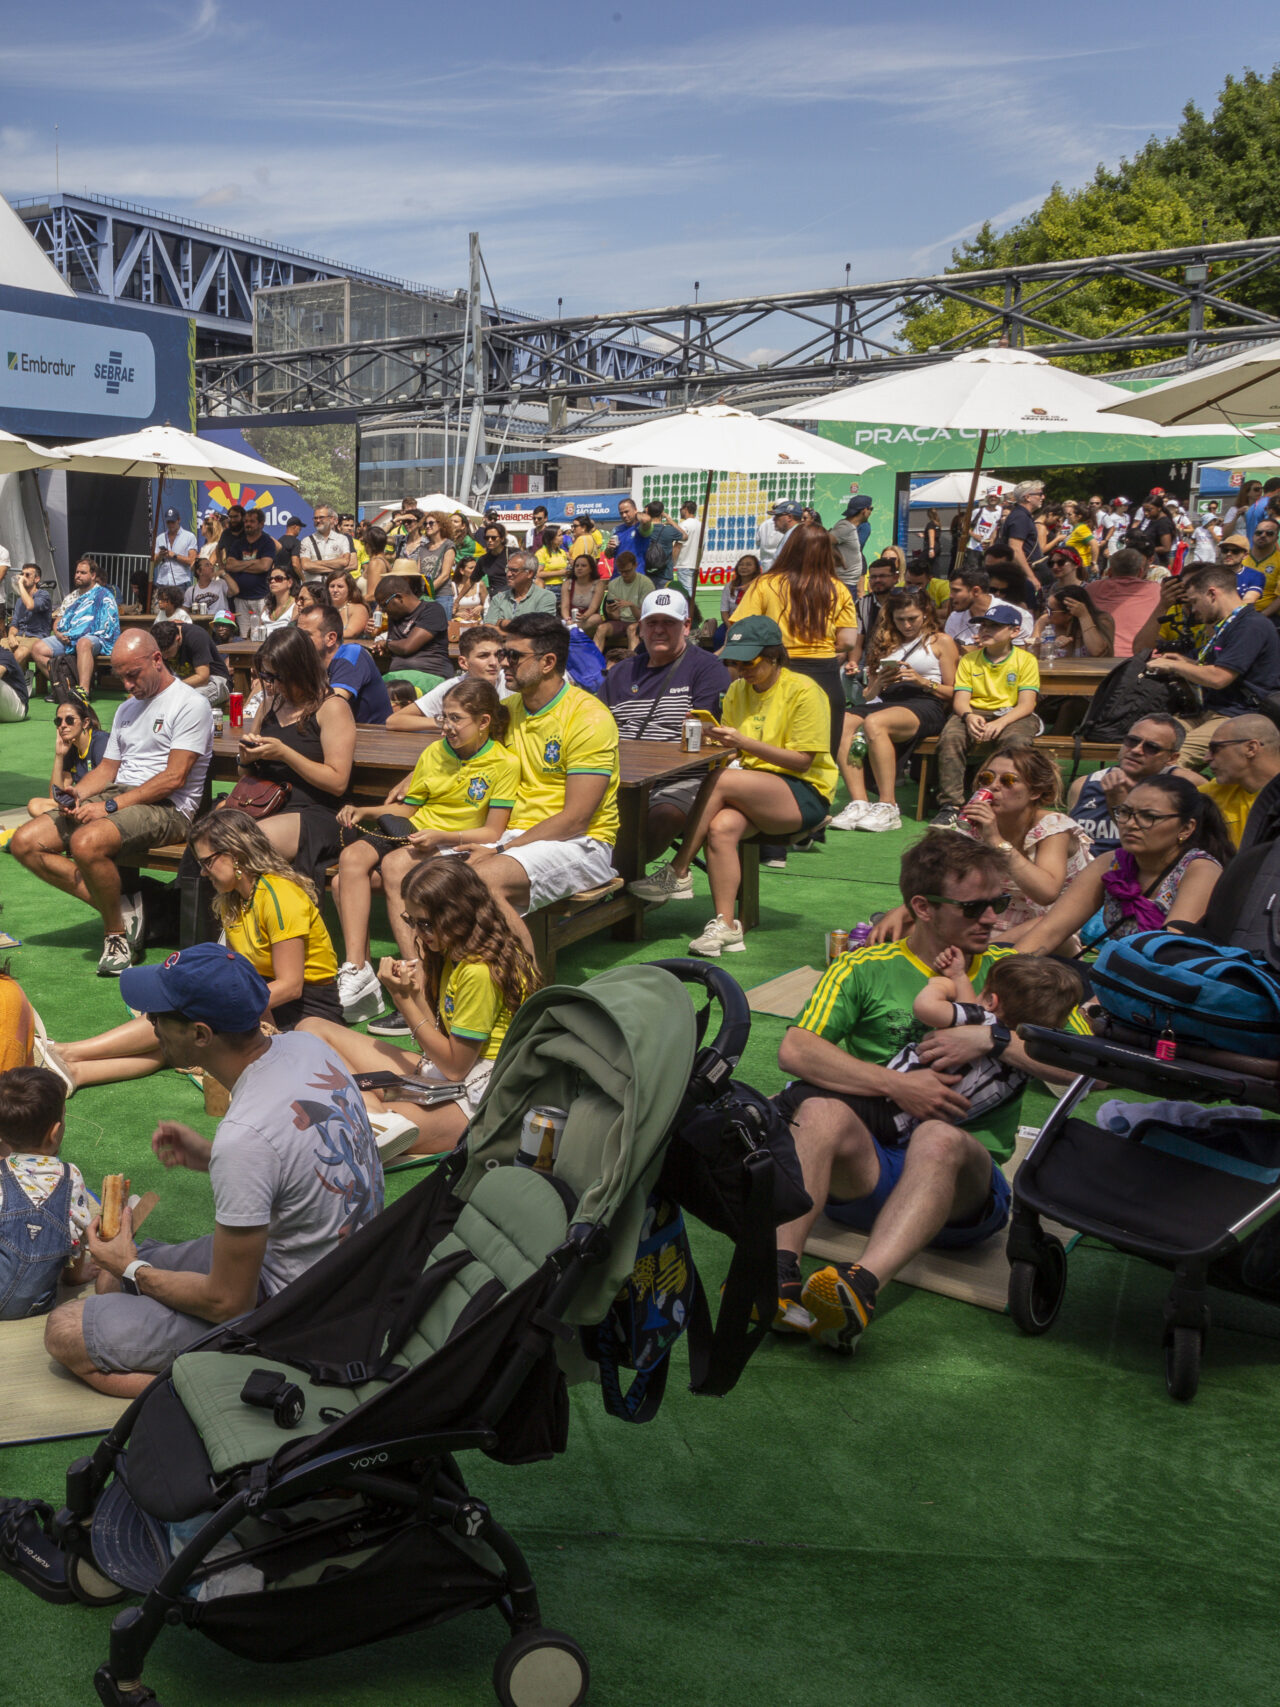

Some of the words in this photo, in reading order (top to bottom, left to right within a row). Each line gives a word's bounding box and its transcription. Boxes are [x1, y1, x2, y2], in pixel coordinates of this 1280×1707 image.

[21, 353, 76, 377] Embratur
[94, 363, 135, 383] SEBRAE
[855, 426, 952, 446] PRAÇA
[1077, 818, 1120, 839] FRAN
[349, 1452, 388, 1470] YOYO
